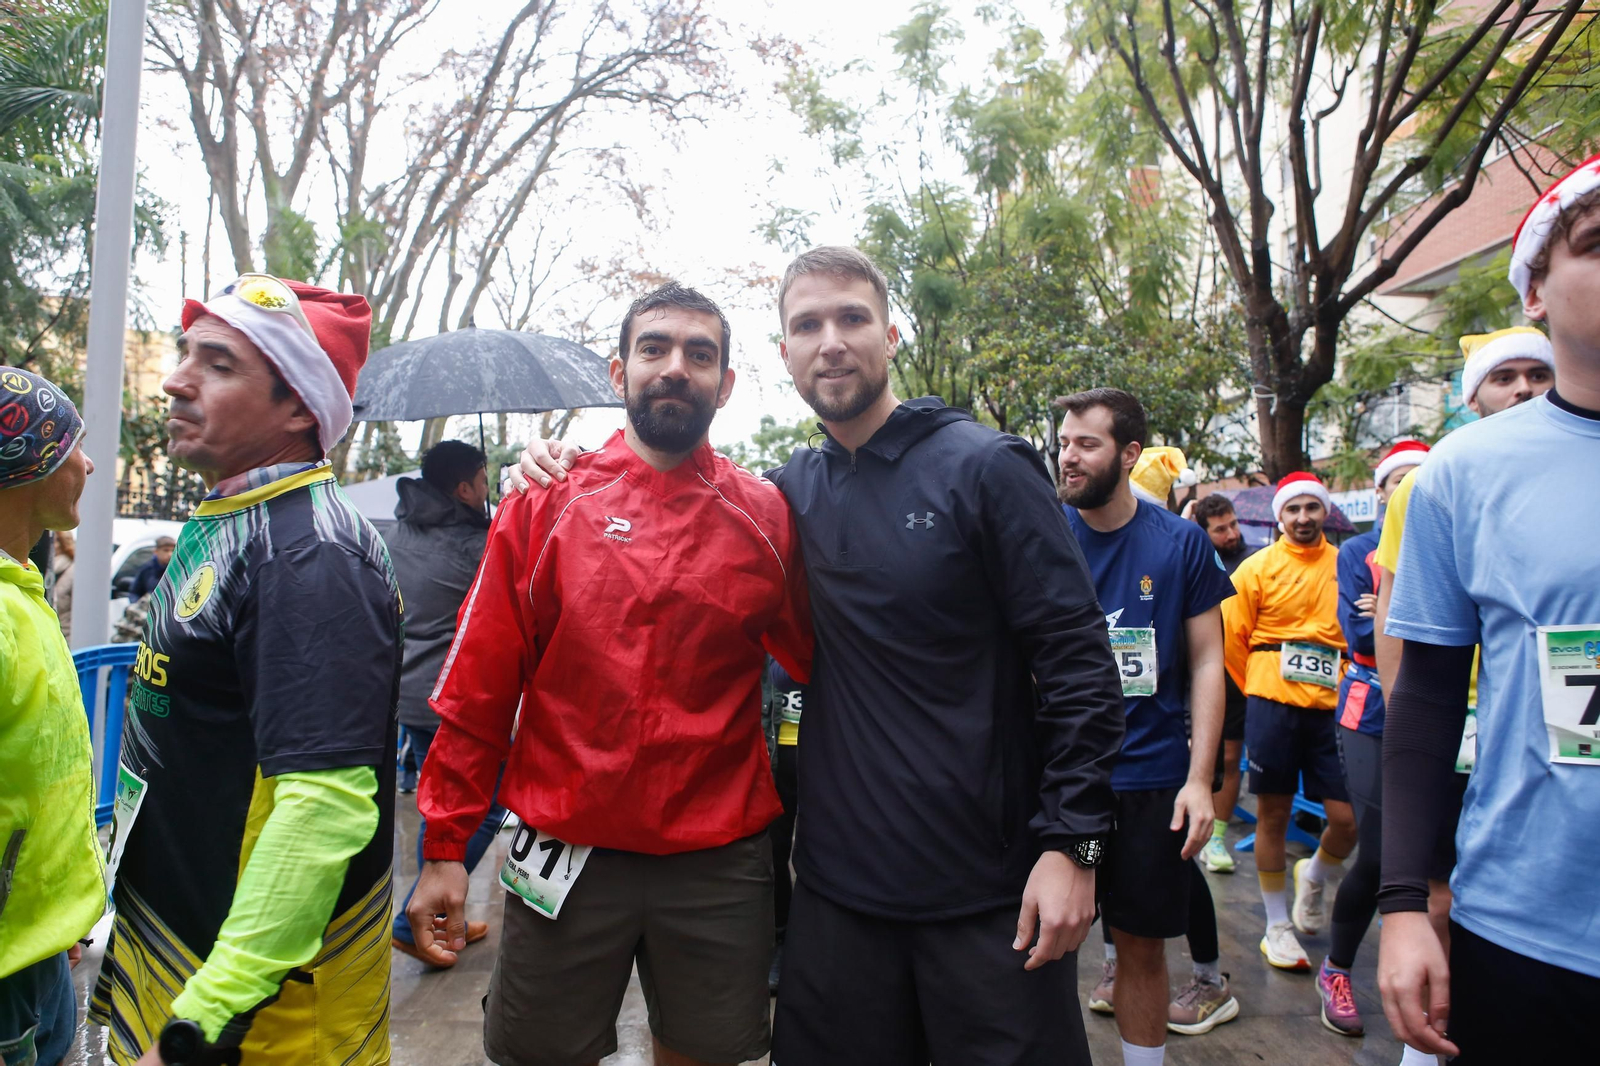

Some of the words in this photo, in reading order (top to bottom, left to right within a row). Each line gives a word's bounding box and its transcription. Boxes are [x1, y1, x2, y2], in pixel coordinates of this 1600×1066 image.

[1287, 653, 1333, 676] 436
[1564, 674, 1600, 725] 7
[509, 819, 566, 881] 01
